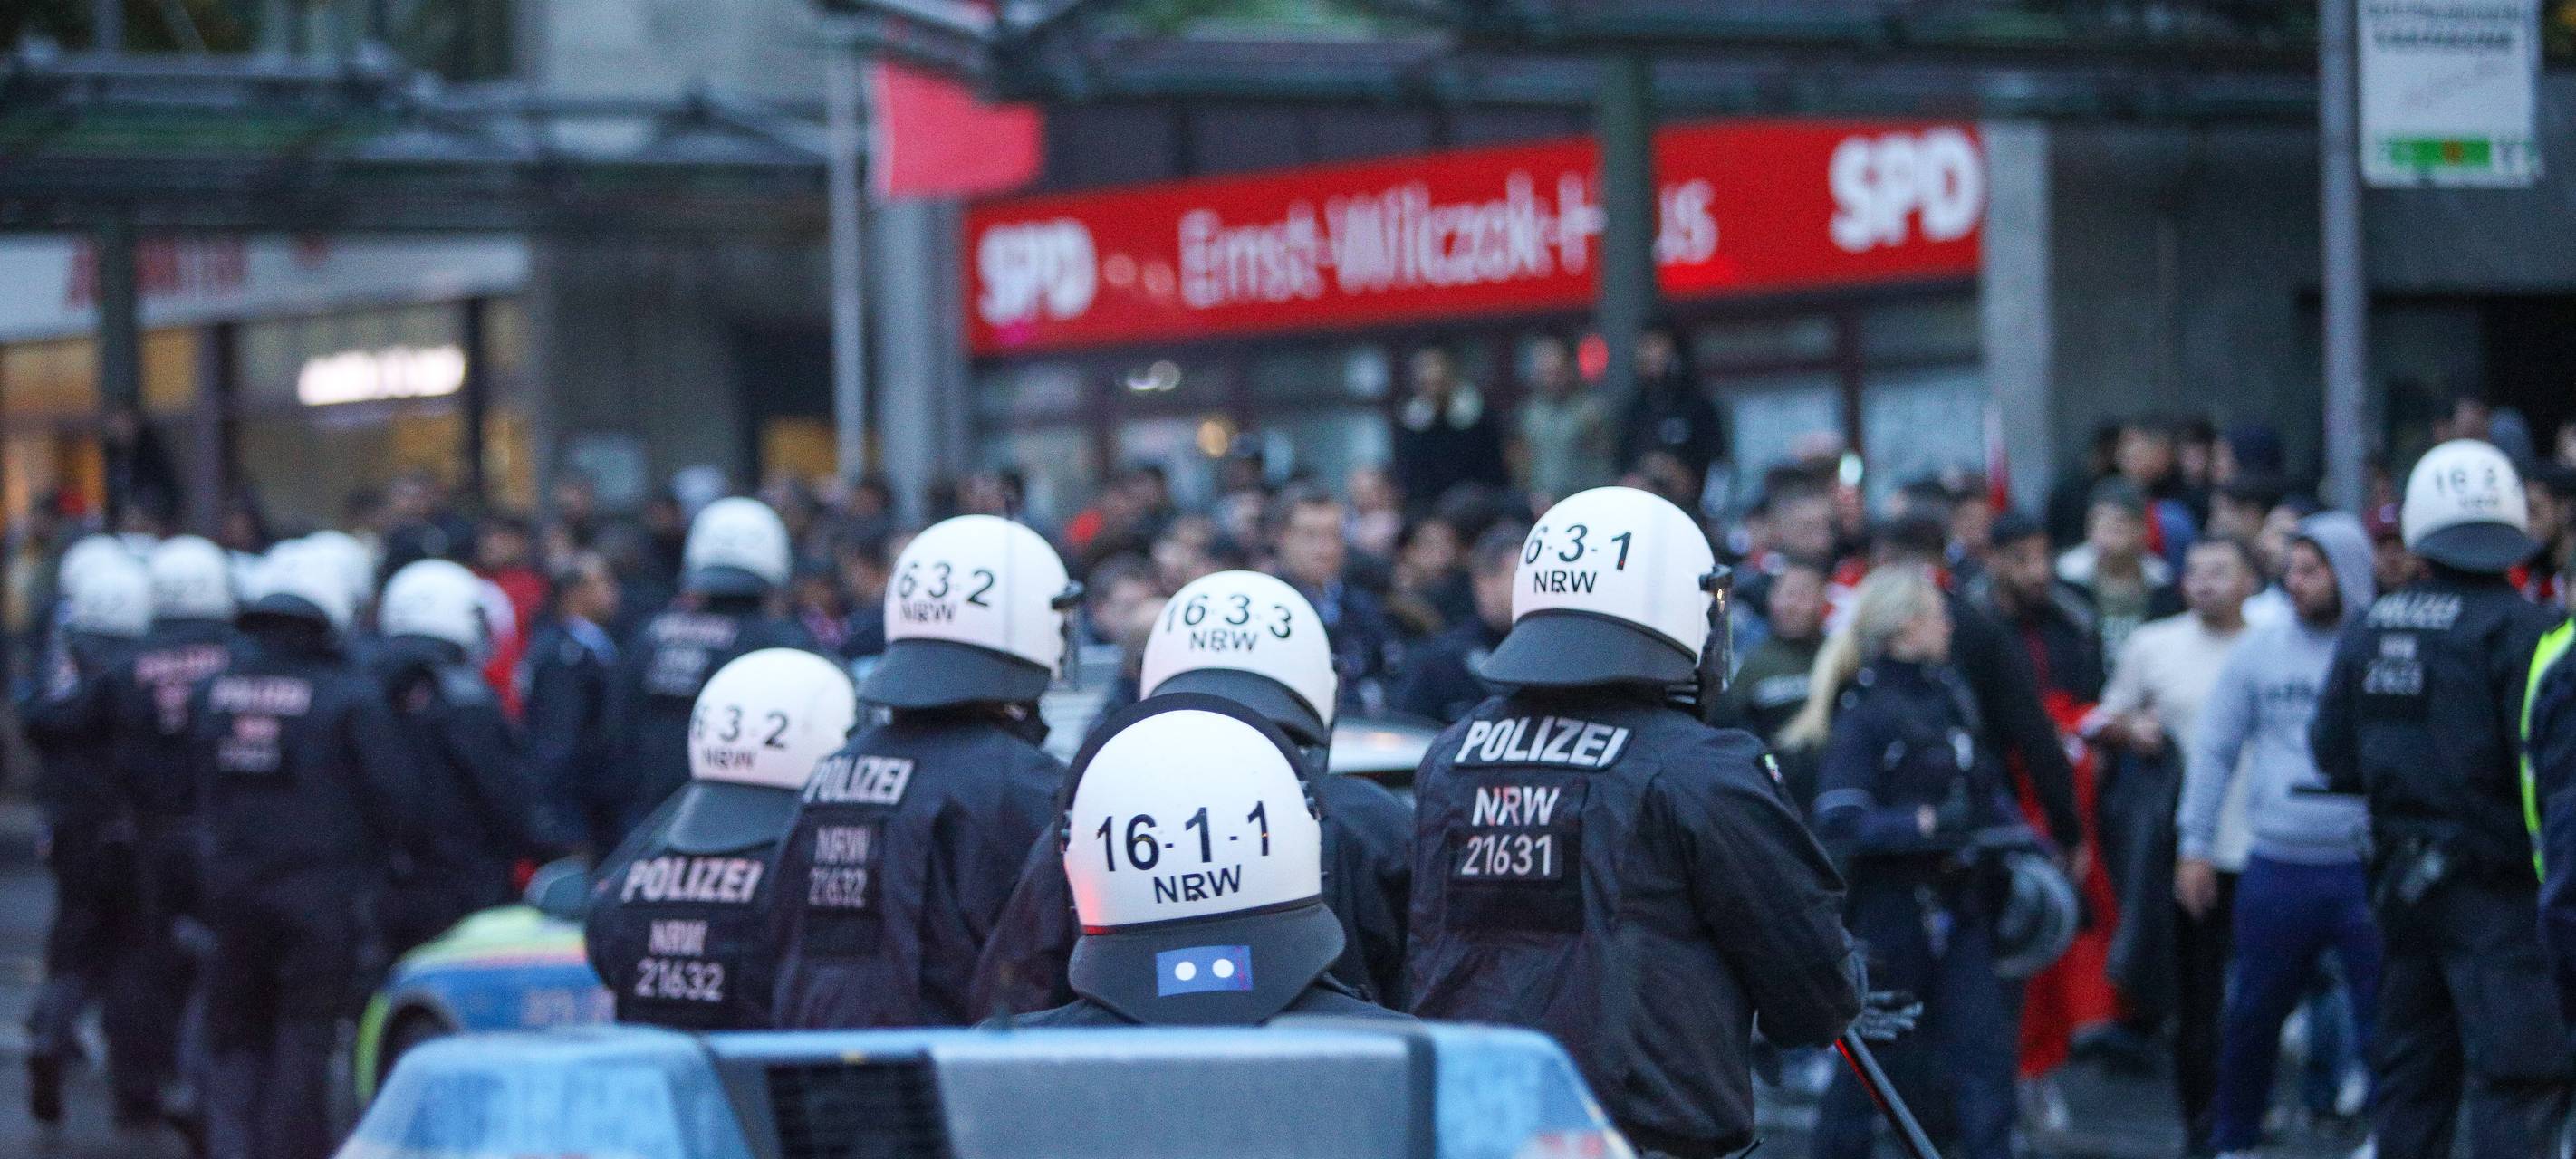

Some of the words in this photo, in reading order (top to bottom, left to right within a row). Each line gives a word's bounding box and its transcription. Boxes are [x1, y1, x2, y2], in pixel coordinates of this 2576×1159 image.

[1828, 129, 1985, 252] SPD
[978, 216, 1098, 326] SPD
[1534, 570, 1598, 595] NRW
[1189, 629, 1258, 652] NRW
[1454, 715, 1630, 768] POLIZEI
[803, 755, 915, 806] POLIZEI
[1471, 785, 1561, 828] NRW
[1095, 800, 1272, 873] 16-1-1
[1460, 833, 1553, 877] 21631
[621, 856, 765, 905] POLIZEI
[1154, 863, 1243, 905] NRW
[636, 957, 725, 1003] 21632
